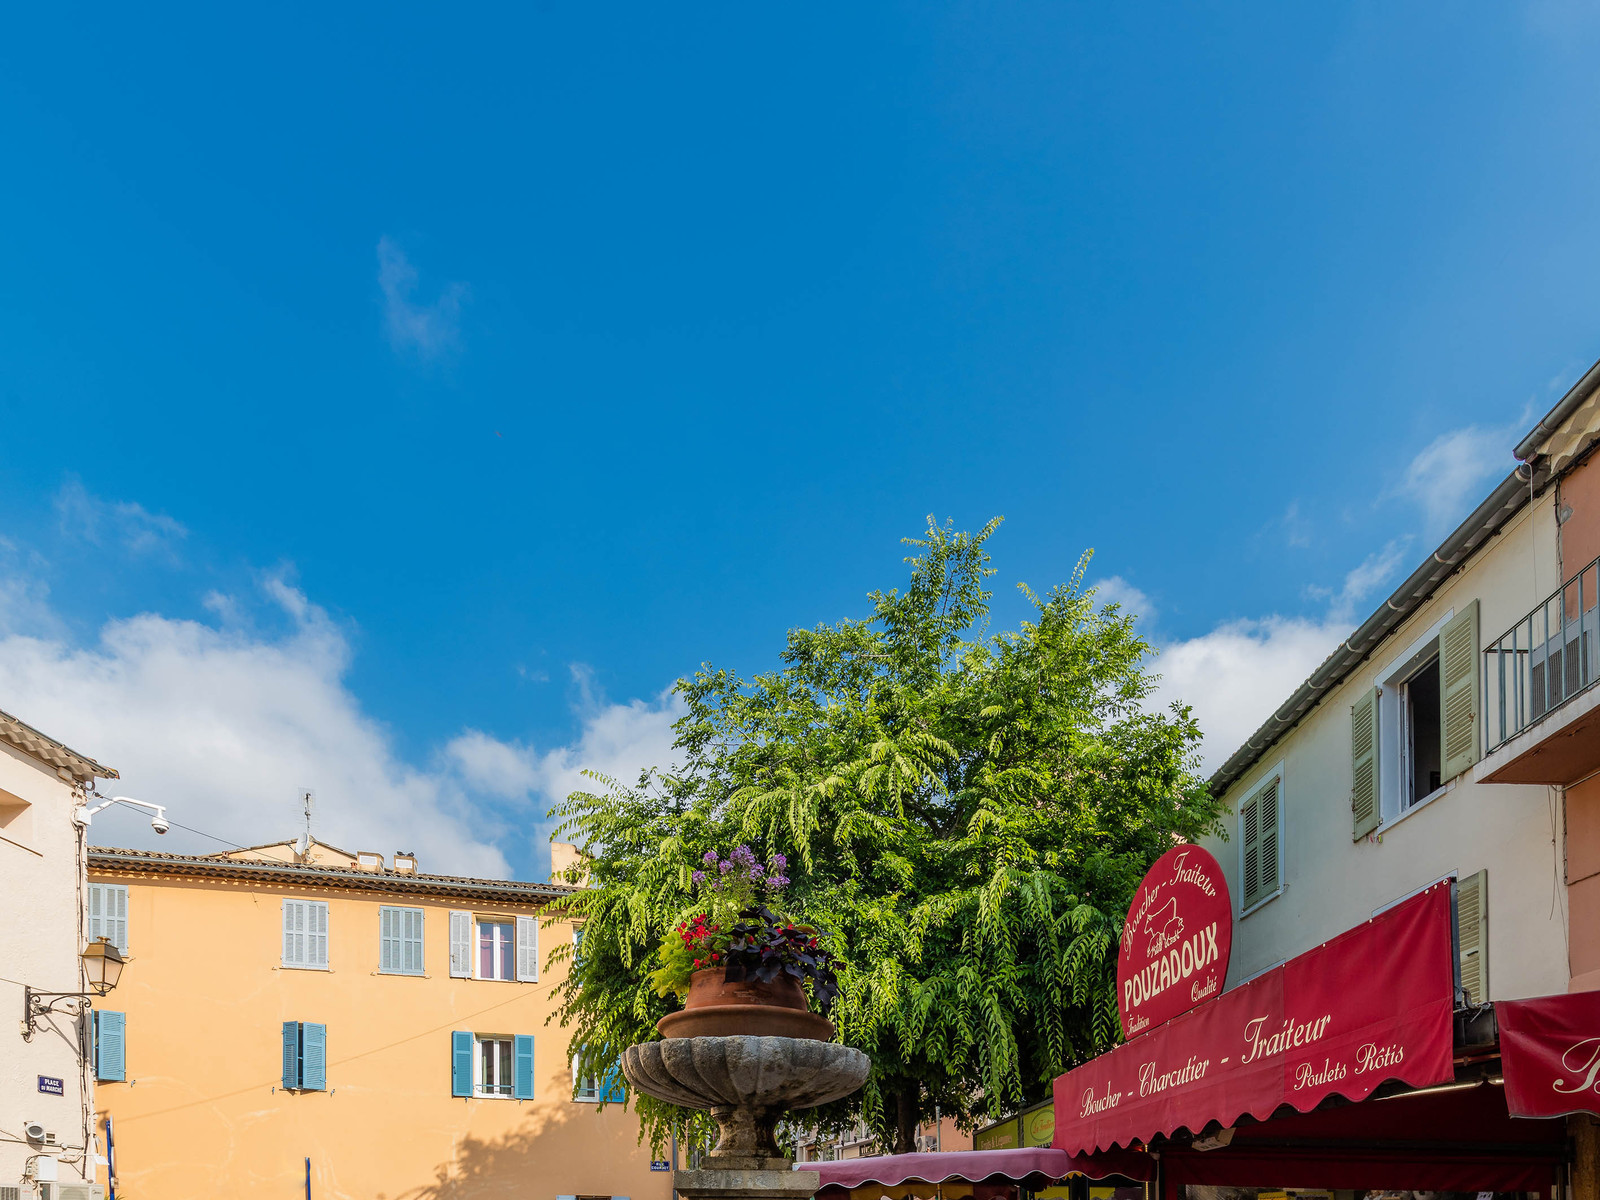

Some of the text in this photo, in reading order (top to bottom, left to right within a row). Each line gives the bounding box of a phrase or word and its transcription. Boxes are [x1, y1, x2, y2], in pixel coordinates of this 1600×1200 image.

[1123, 887, 1160, 961] Boucher
[1170, 850, 1216, 898] Traiteur
[1124, 921, 1219, 1013] POUZADOUX
[1191, 976, 1218, 1003] Qualité
[1127, 1014, 1150, 1036] Tradition
[44, 1078, 60, 1087] PLACE
[1080, 1080, 1122, 1119] Boucher
[1138, 1055, 1210, 1098] Charcutier
[1241, 1014, 1332, 1065] Traiteur
[1294, 1042, 1404, 1091] Poulets Rôtis
